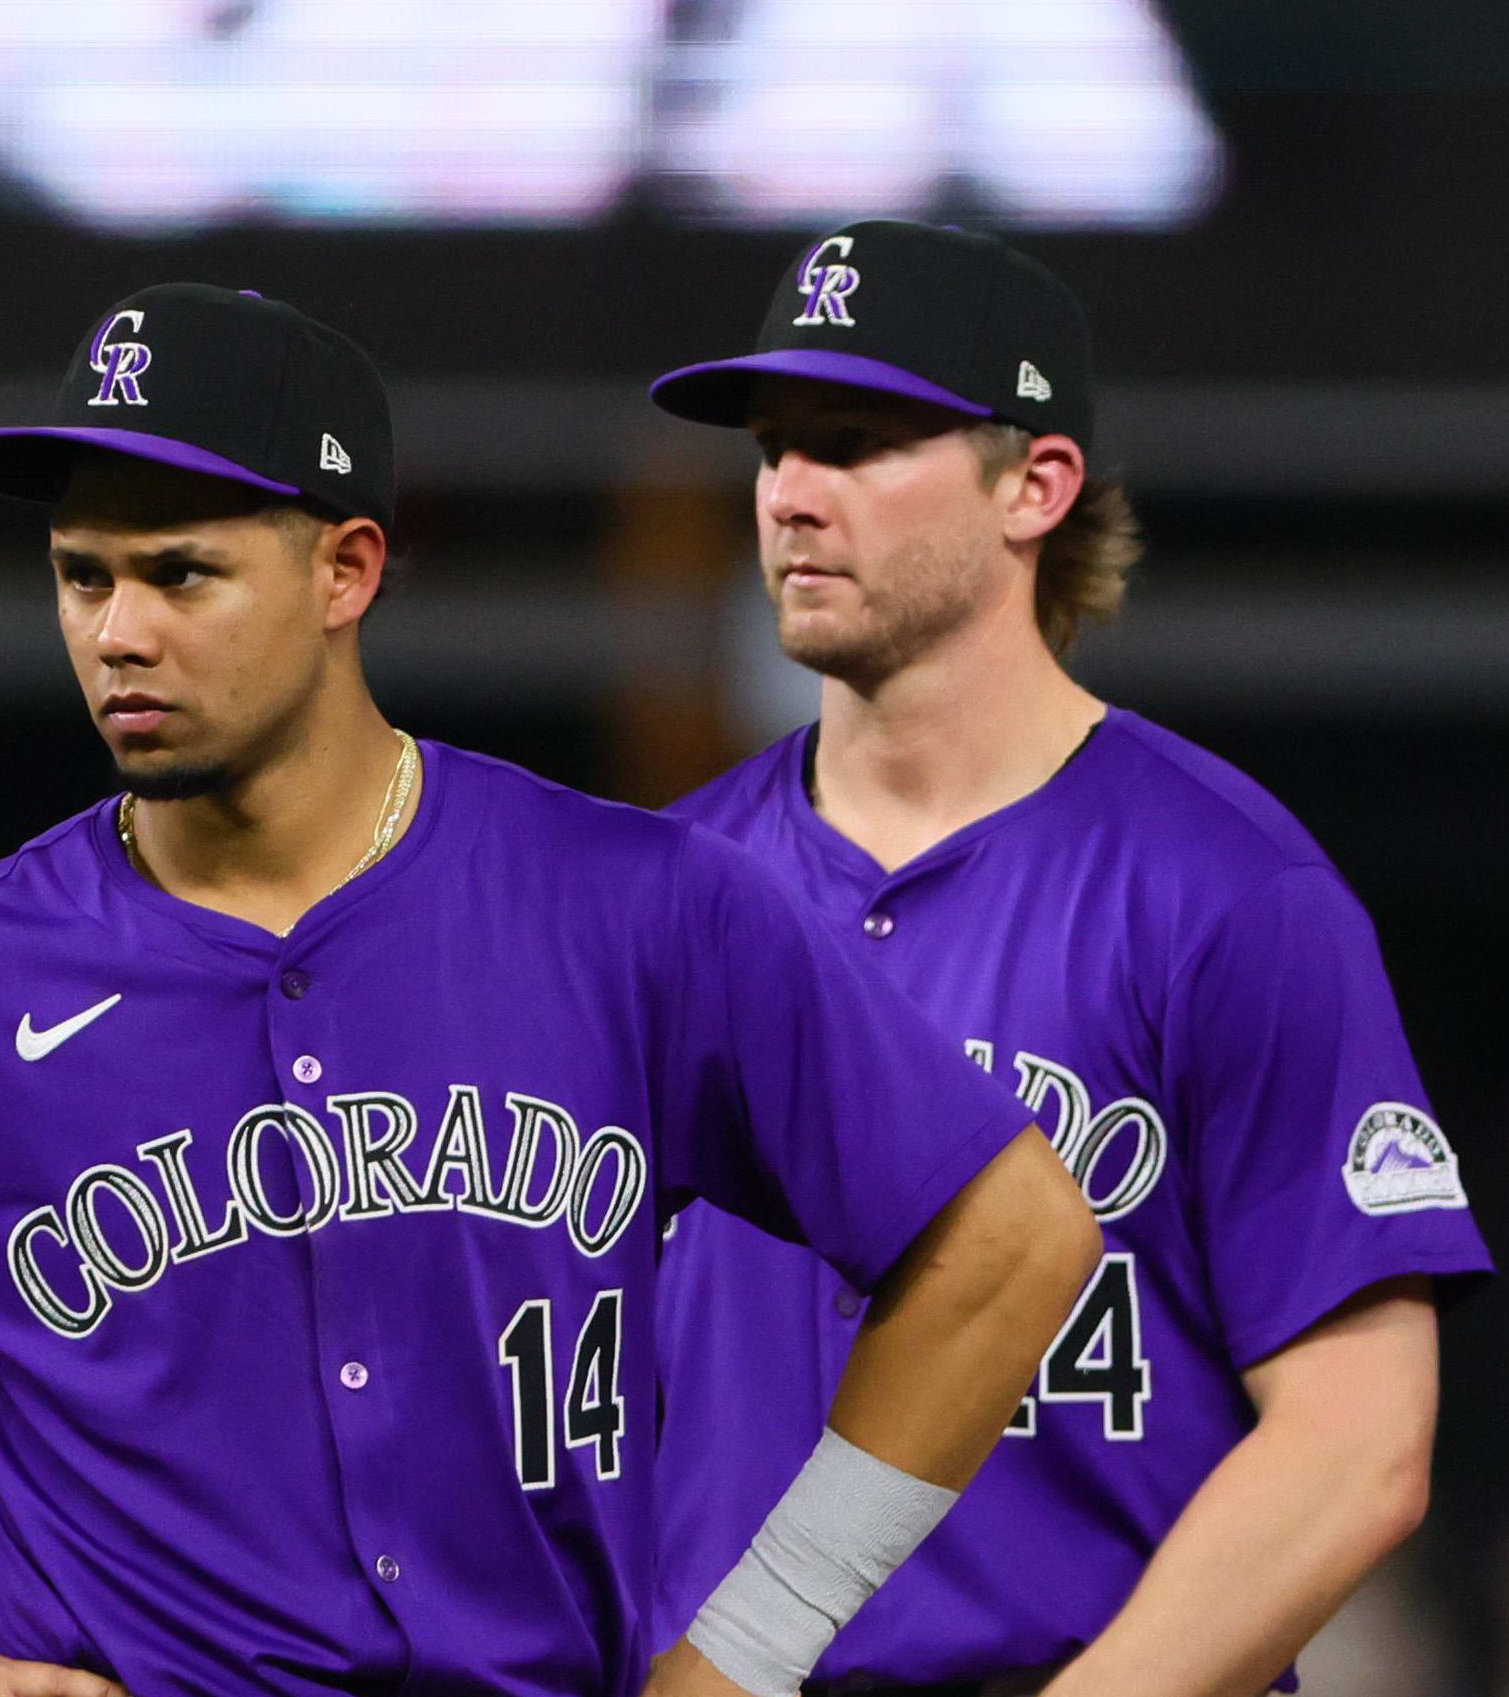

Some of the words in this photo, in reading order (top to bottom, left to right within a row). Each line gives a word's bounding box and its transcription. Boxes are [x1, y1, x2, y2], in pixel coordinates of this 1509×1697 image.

[6, 1084, 647, 1340] COLORADO
[498, 1288, 626, 1492] 14
[1000, 1251, 1152, 1441] 4
